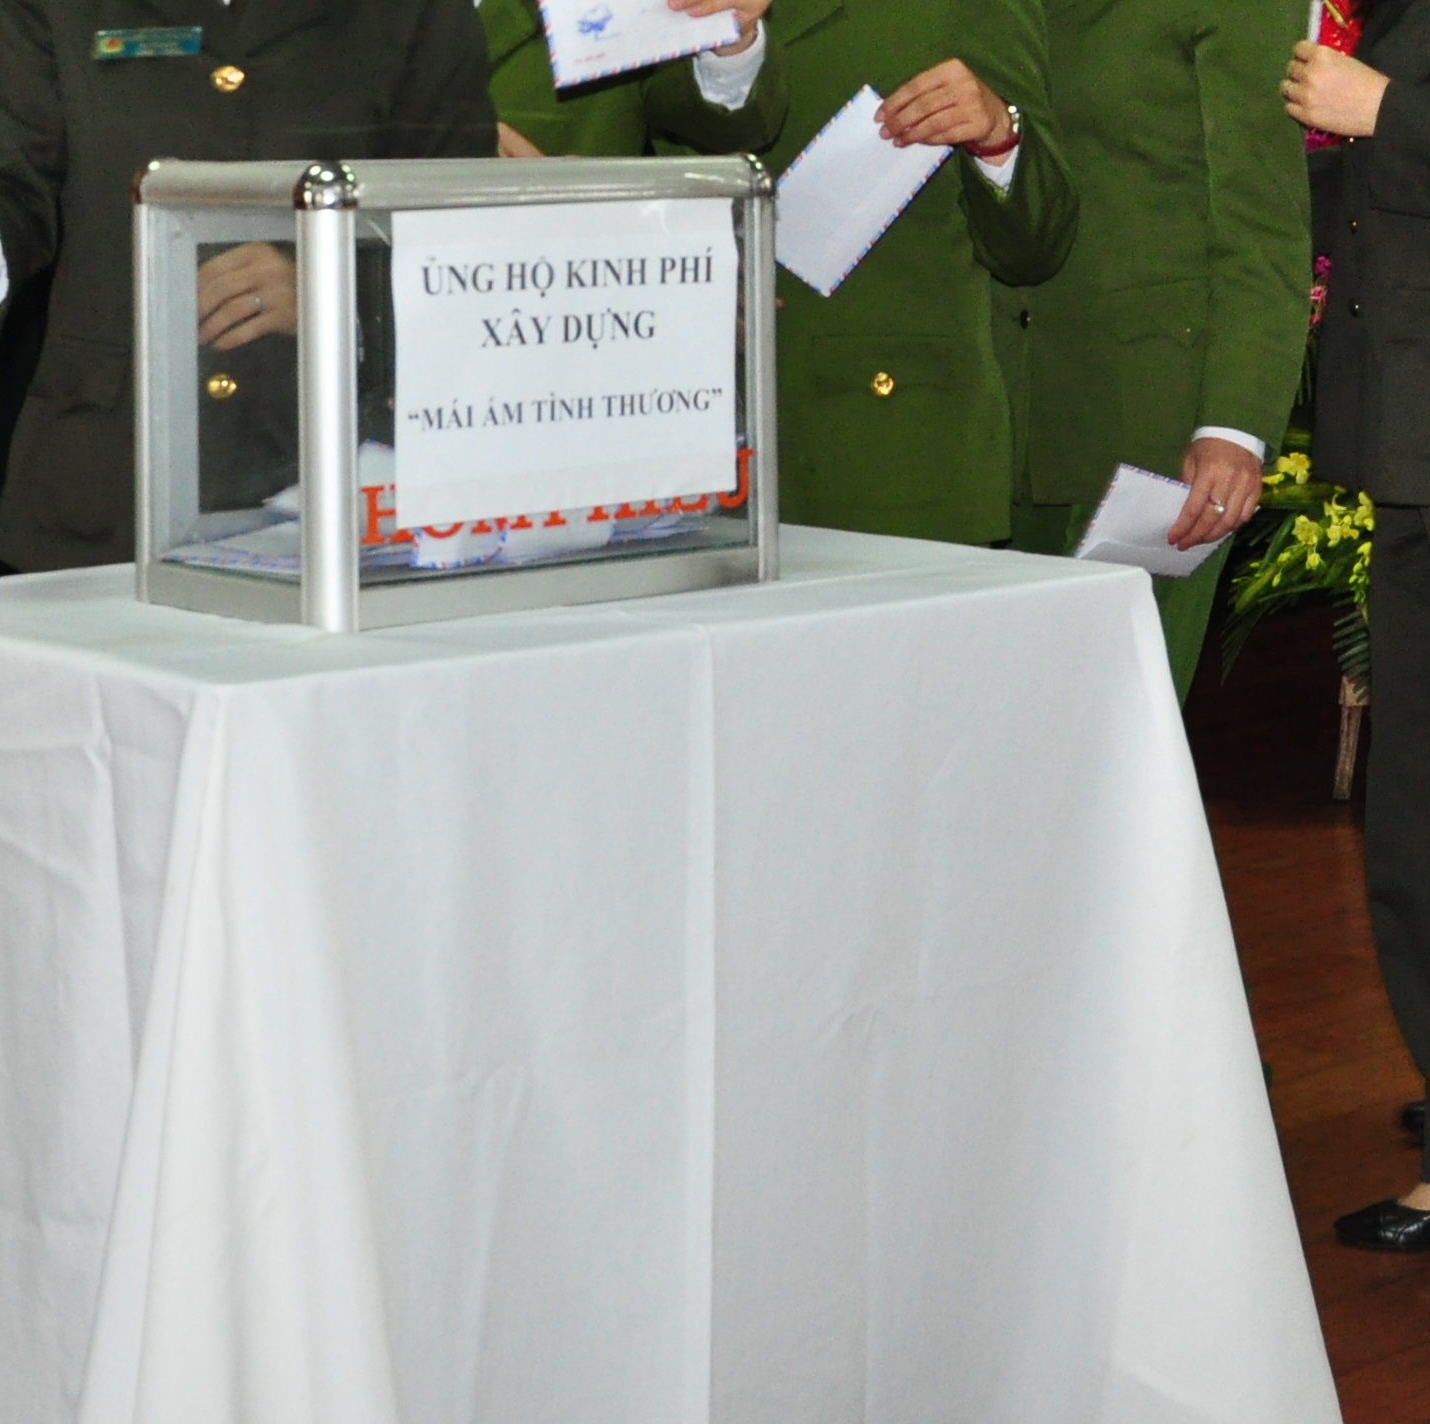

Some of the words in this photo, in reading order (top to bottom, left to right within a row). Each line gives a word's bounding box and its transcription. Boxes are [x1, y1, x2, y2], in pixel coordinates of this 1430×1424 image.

[506, 256, 554, 298] HỘ
[566, 257, 648, 289] KINH
[659, 246, 713, 284] PHÍ
[481, 308, 552, 348] XÂY
[562, 307, 656, 350] DỰNG
[532, 392, 593, 423] TÌNH
